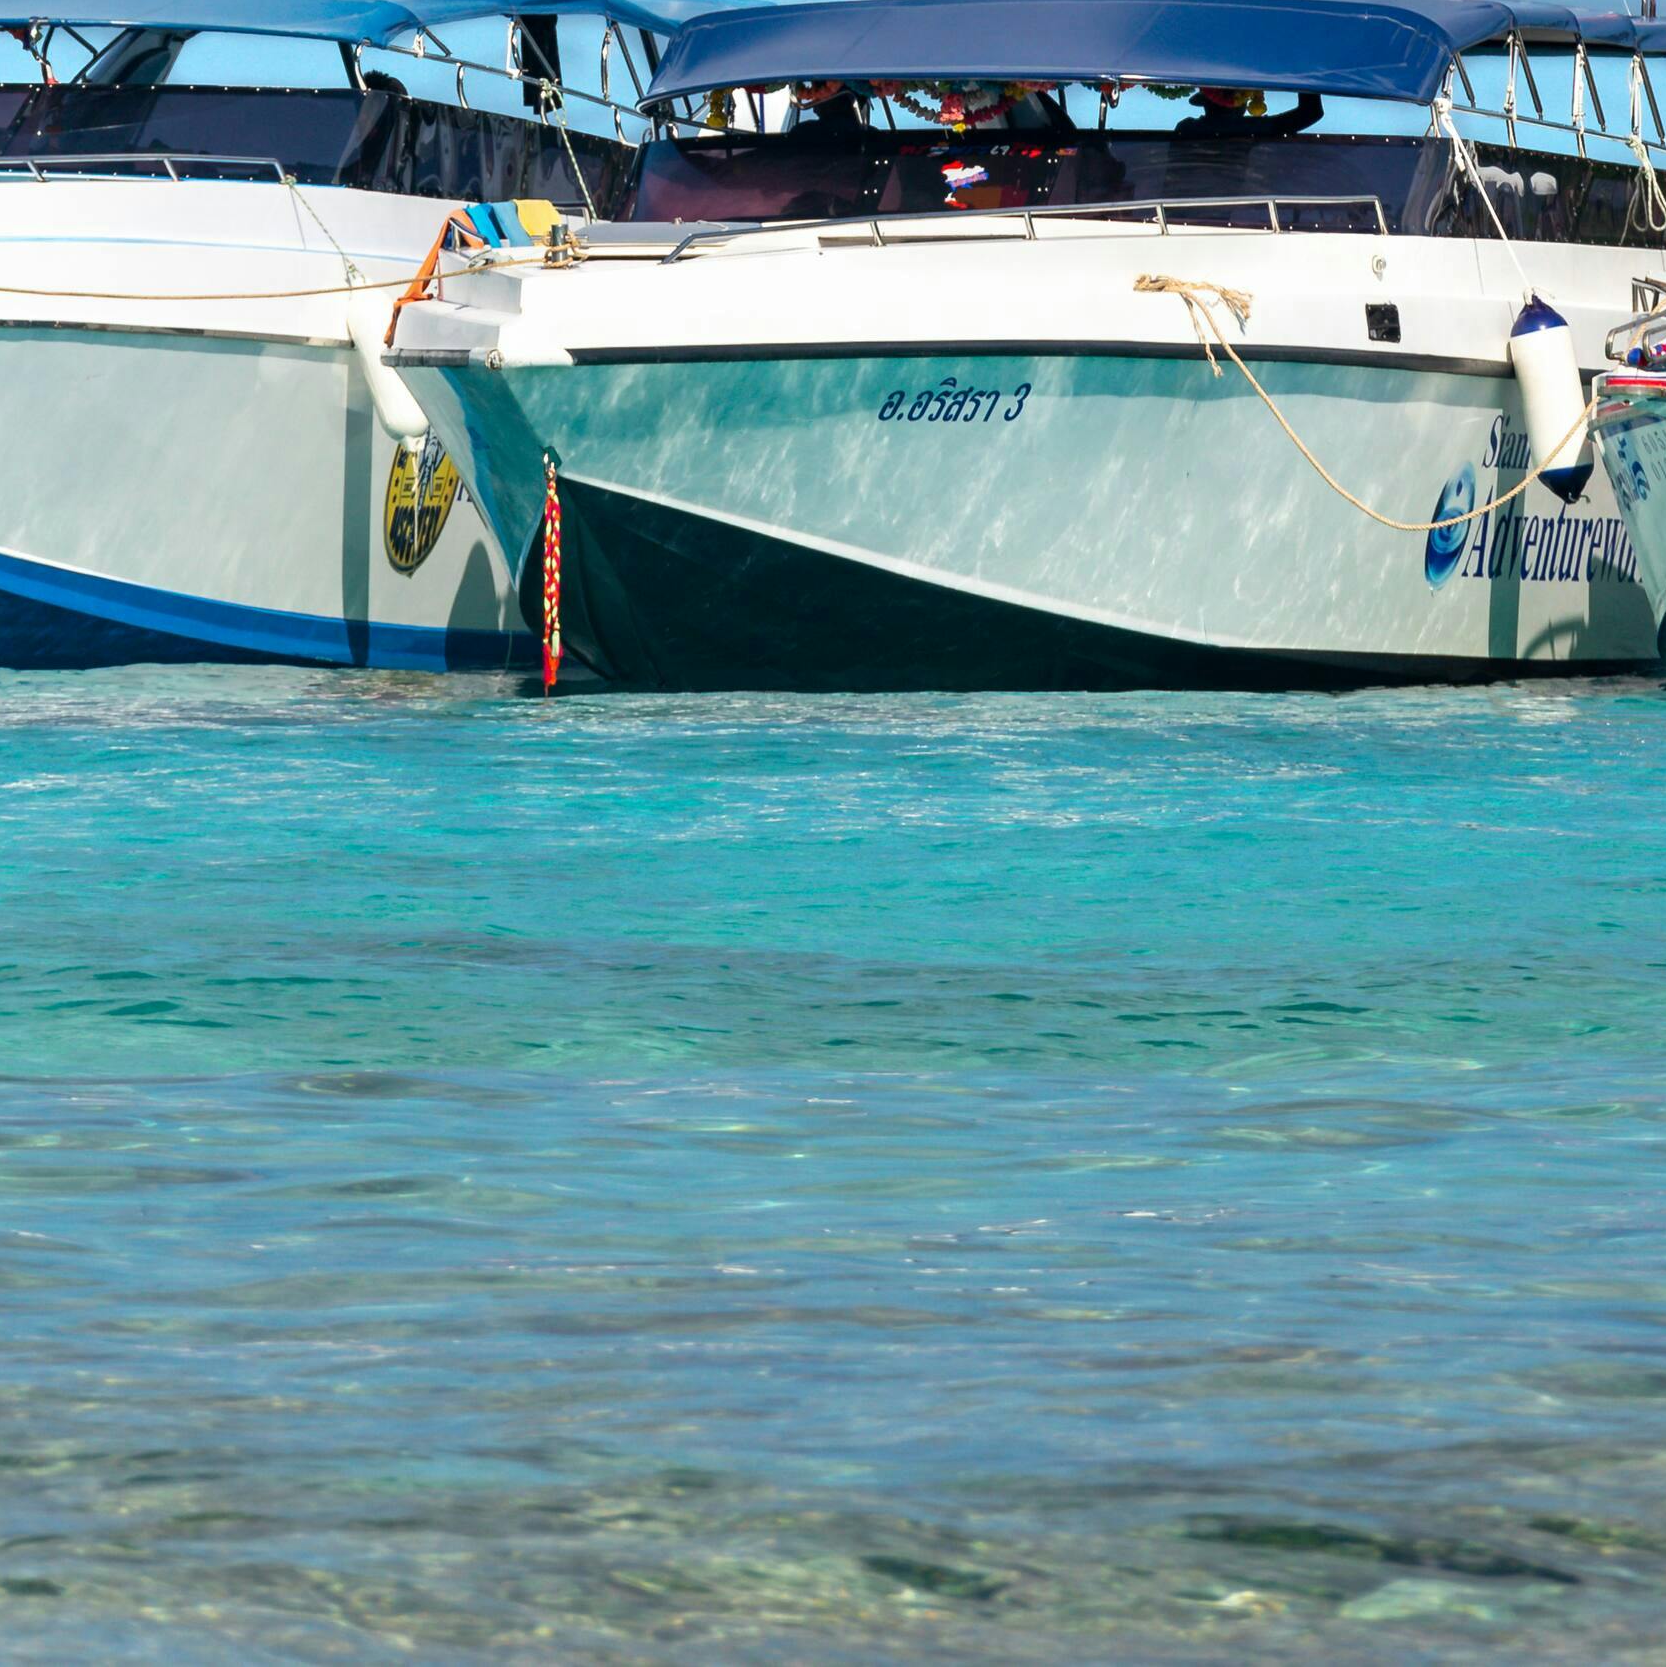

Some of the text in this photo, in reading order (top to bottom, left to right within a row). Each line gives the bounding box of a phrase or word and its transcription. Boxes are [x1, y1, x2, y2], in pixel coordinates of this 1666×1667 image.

[878, 377, 1032, 422] อ.อริสรา 3
